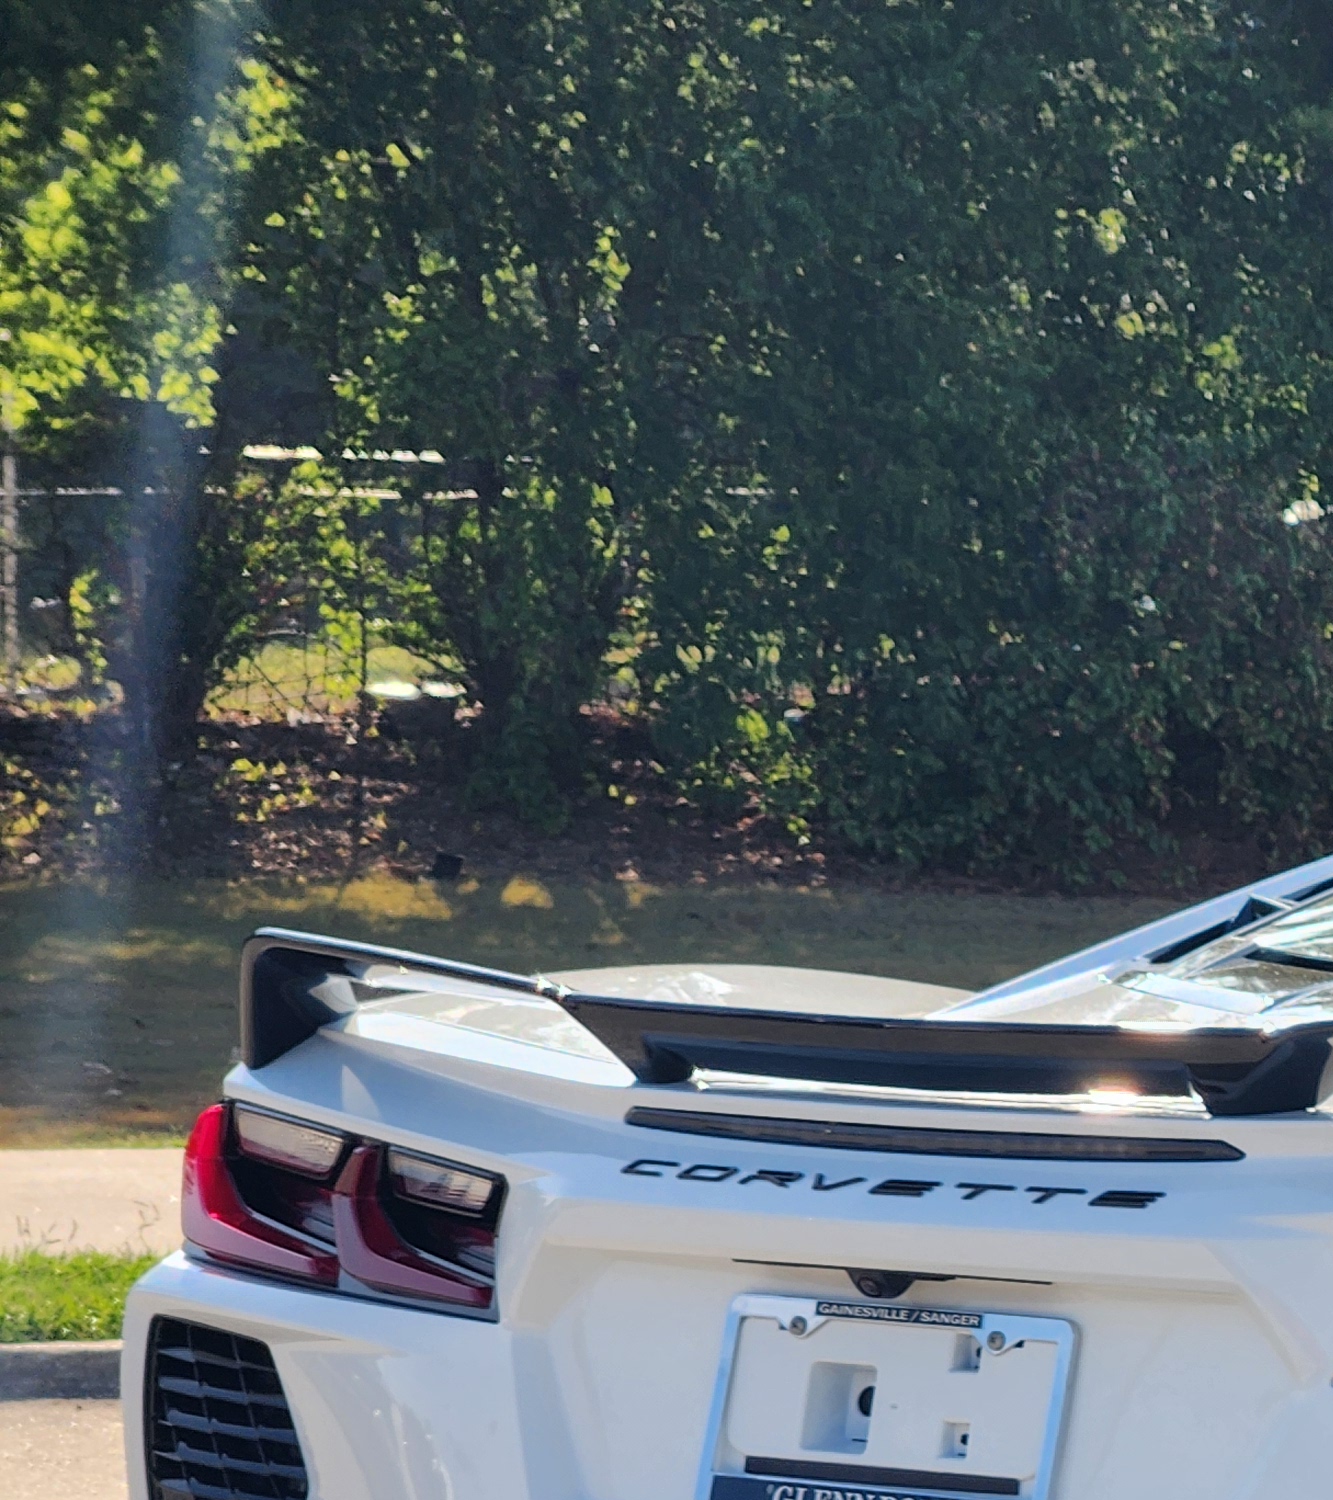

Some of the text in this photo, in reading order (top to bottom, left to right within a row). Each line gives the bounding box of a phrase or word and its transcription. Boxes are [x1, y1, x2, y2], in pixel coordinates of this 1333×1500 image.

[620, 1158, 1167, 1209] CORVETTE
[818, 1303, 909, 1321] GAINESVILLE
[920, 1311, 980, 1326] SANGER
